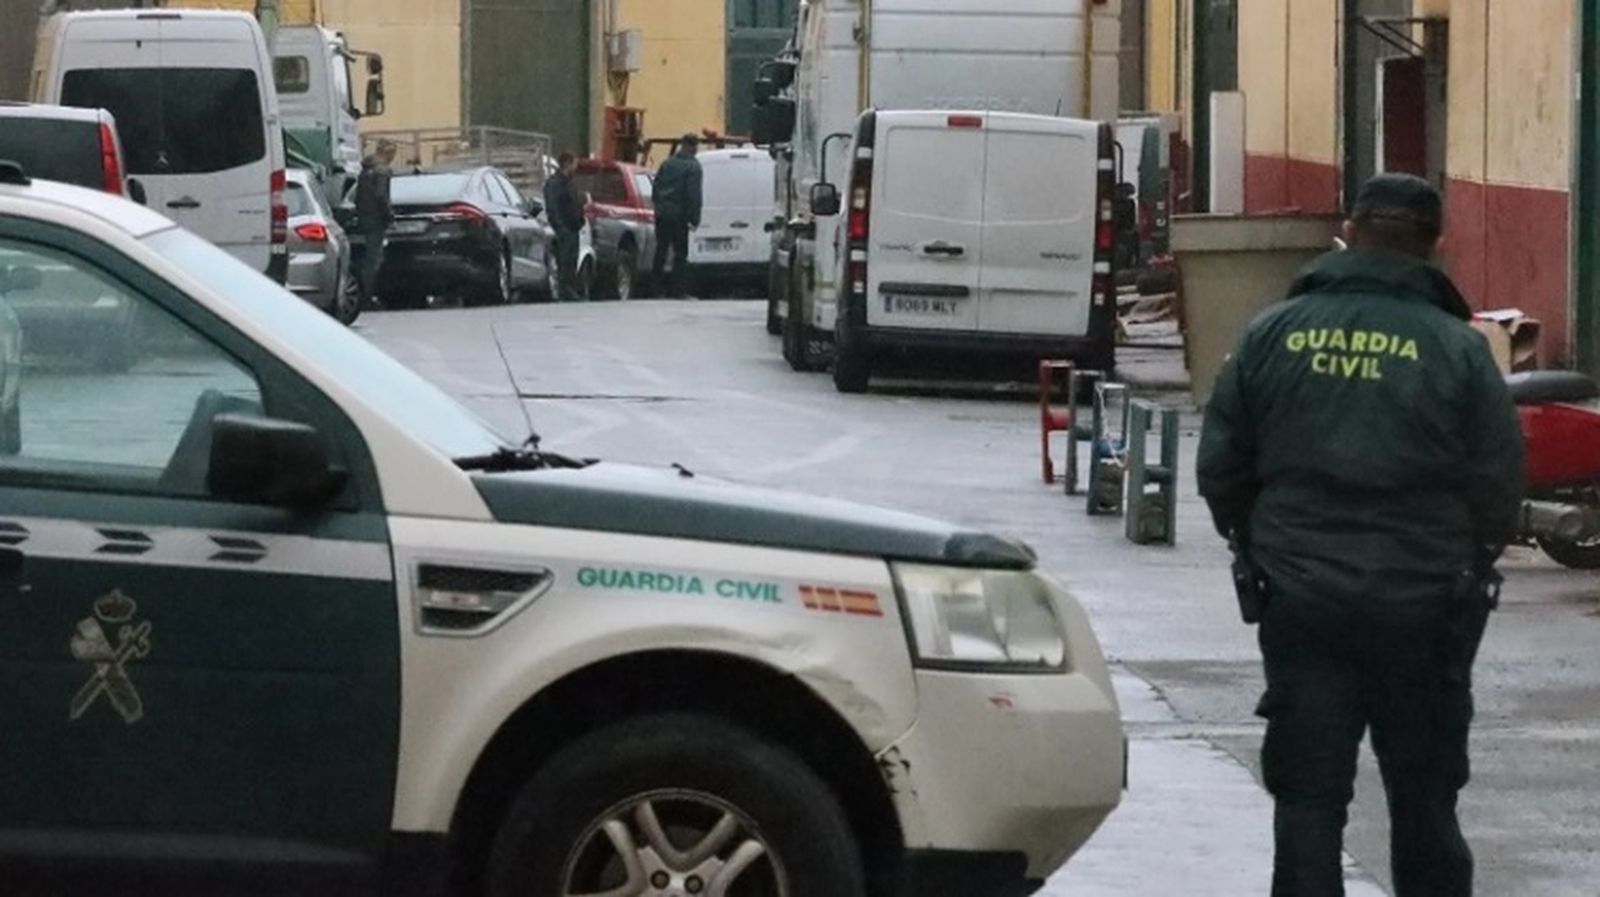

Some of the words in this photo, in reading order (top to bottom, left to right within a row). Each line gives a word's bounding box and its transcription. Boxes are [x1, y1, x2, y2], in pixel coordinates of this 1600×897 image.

[1286, 329, 1418, 360] GUARDIA
[1312, 352, 1381, 378] CIVIL
[577, 566, 705, 594] GUARDIA
[715, 579, 784, 603] CIVIL
